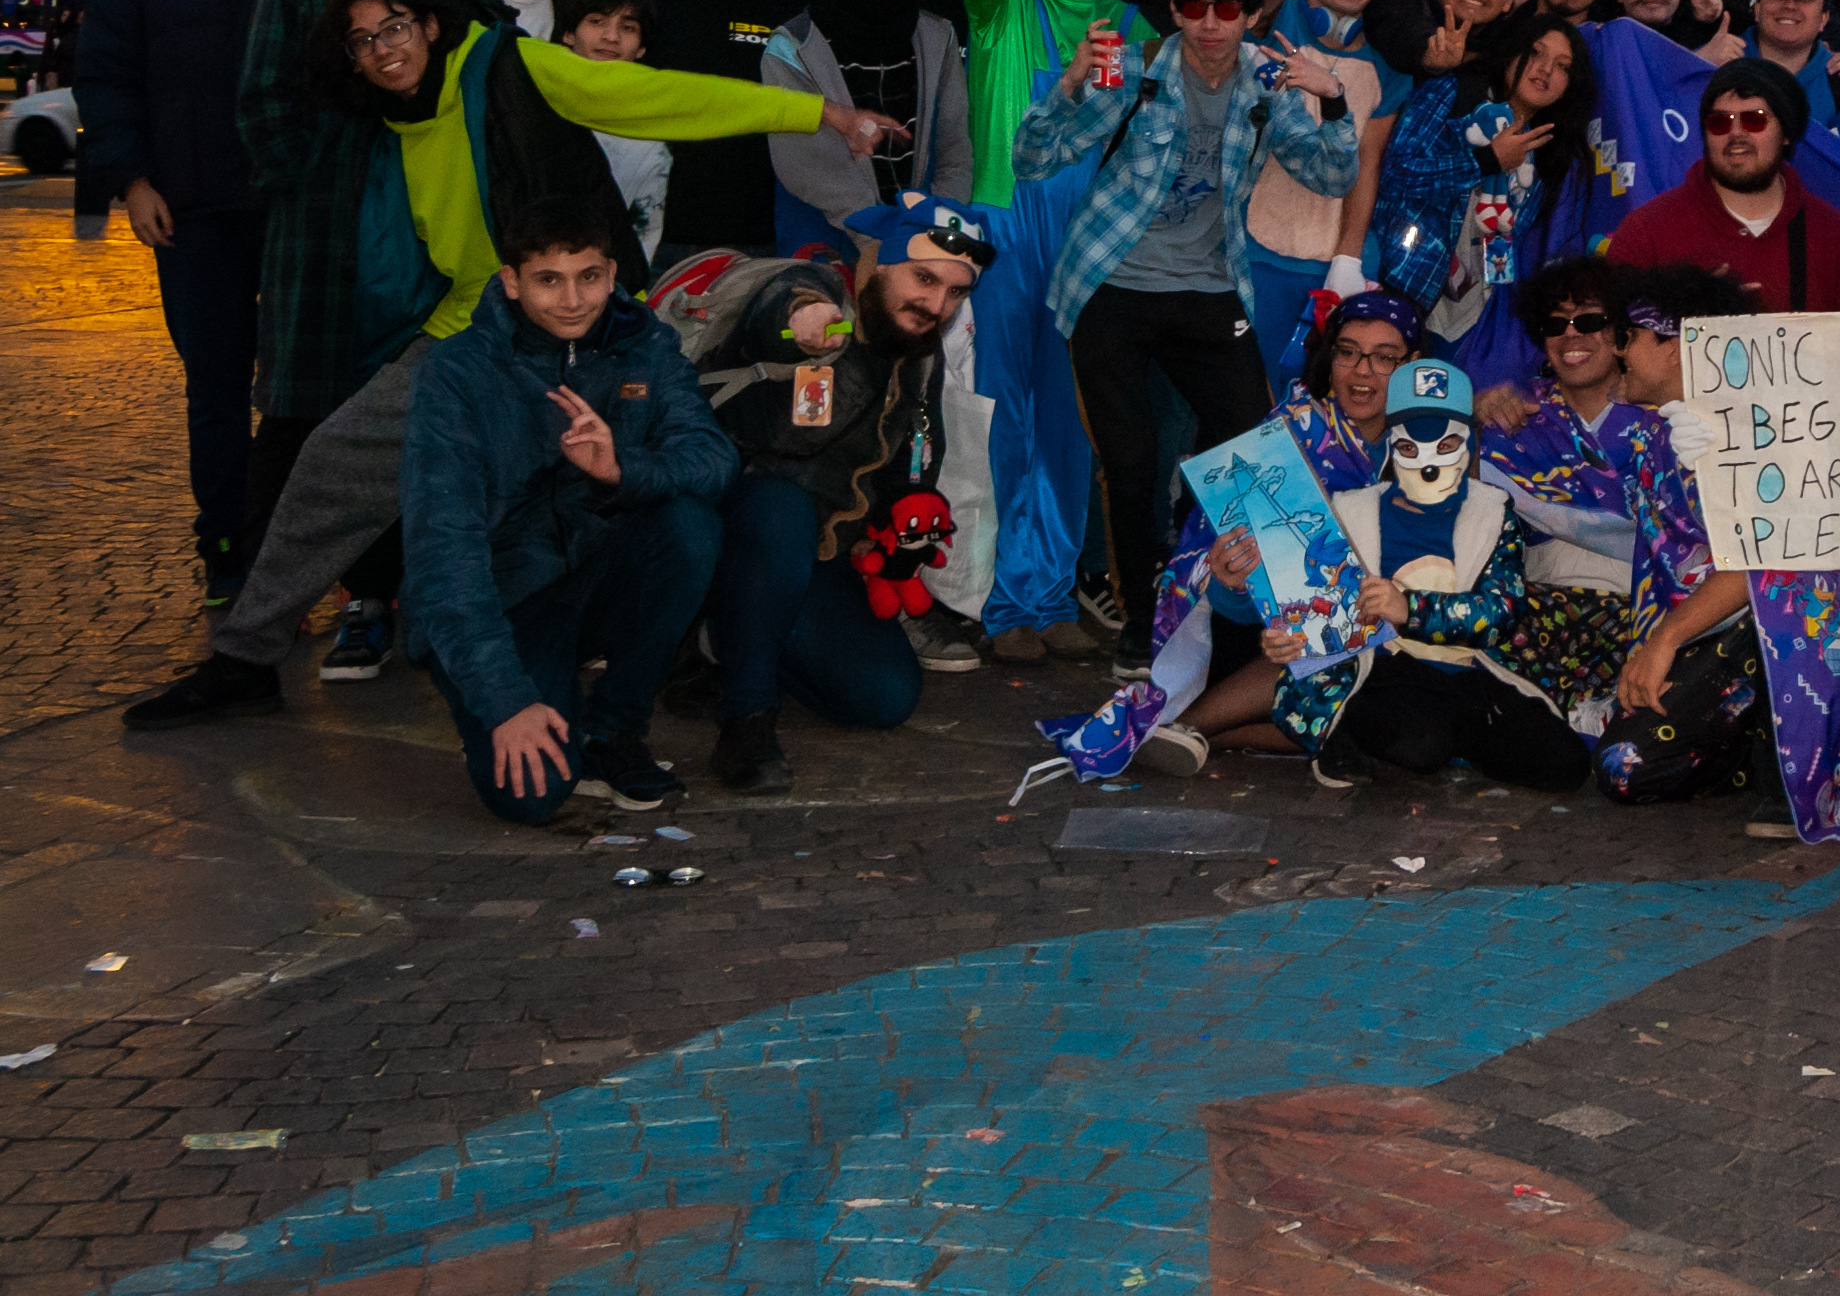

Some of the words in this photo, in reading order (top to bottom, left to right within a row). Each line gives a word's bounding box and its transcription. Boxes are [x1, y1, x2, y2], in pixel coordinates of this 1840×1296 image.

[1714, 407, 1740, 453] I
[1752, 401, 1836, 450] BEG
[1718, 461, 1786, 507] TO
